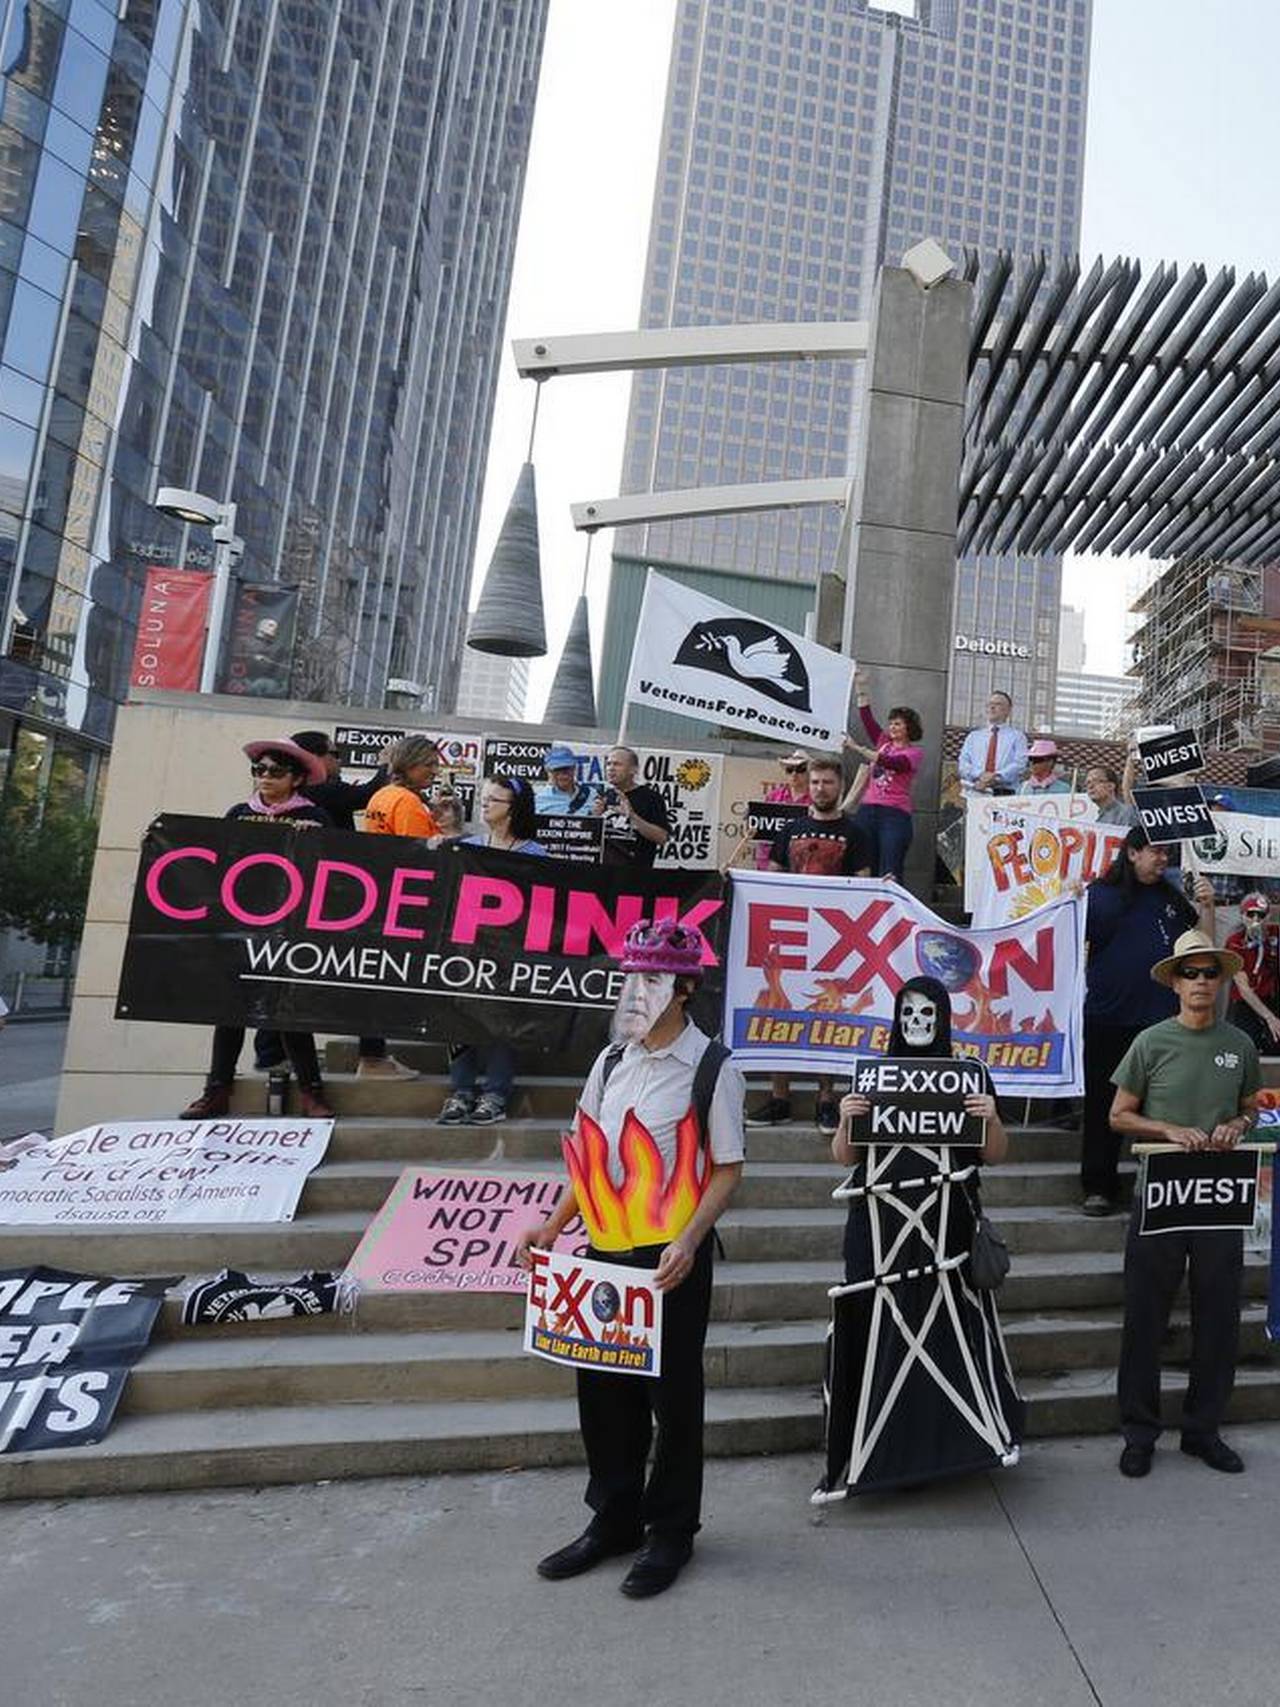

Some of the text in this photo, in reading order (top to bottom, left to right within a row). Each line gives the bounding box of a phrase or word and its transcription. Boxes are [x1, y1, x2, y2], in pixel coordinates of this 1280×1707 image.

[138, 580, 172, 687] SOLUNA
[639, 680, 831, 741] VeteransForPeace.org
[493, 761, 542, 778] KNEW
[1143, 743, 1201, 772] DIVEST
[748, 814, 793, 832] DIVE
[1140, 803, 1208, 829] DIVEST
[144, 846, 726, 967] CODE PINK
[245, 938, 626, 1001] WOMEN FOR PEACE
[746, 1015, 804, 1044] Liar
[809, 1019, 865, 1048] Liar
[987, 1041, 1051, 1068] Fire!
[857, 1064, 980, 1096] #EXXON
[871, 1105, 966, 1135] KNEW
[128, 1122, 203, 1152] and
[205, 1122, 314, 1149] Planet
[0, 1184, 79, 1201] mocratic
[82, 1184, 165, 1202] Socialists
[188, 1181, 261, 1200] America
[1147, 1178, 1256, 1210] DIVEST
[428, 1207, 513, 1234] NOT
[0, 1279, 146, 1316] OPLE
[571, 1342, 602, 1362] Earth
[618, 1349, 647, 1367] Fire!
